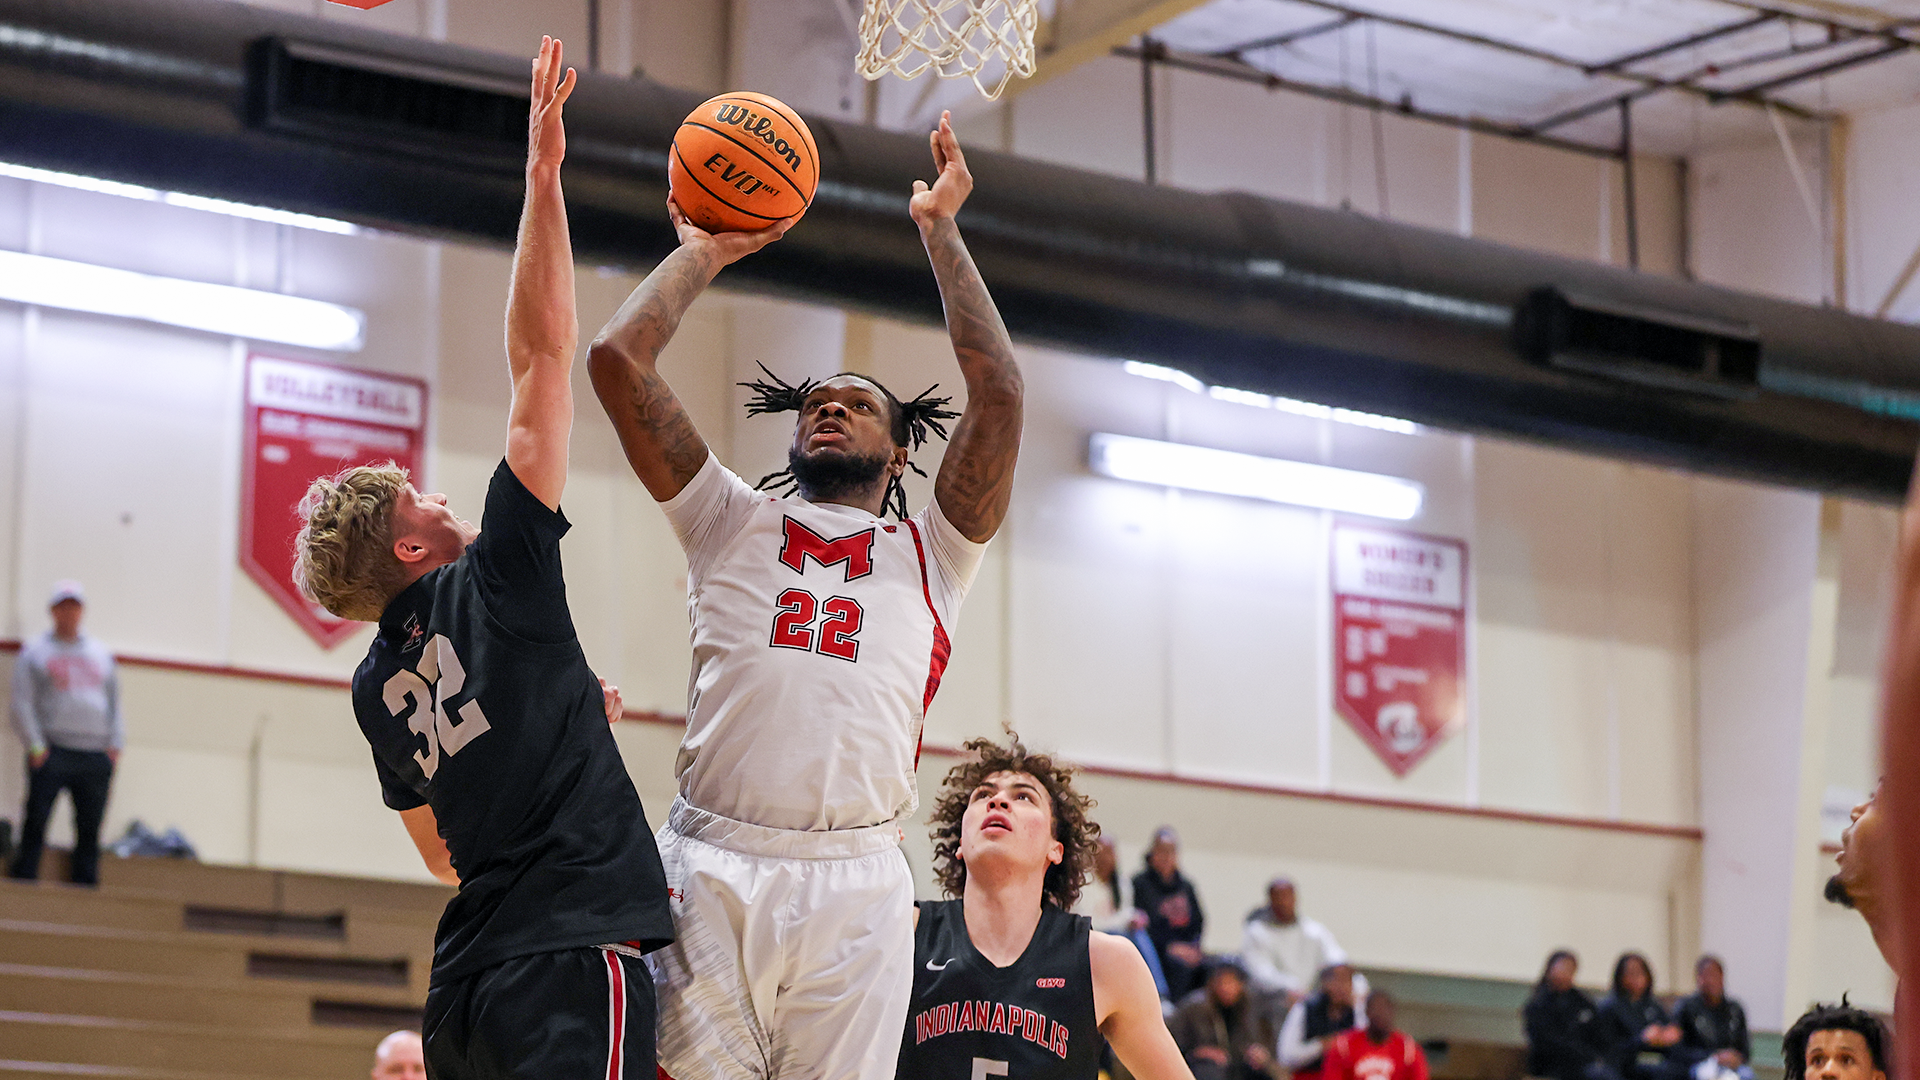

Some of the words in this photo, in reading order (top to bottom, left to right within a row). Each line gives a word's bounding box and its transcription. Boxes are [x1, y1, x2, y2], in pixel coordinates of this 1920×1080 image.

[715, 103, 801, 173] Wilson
[703, 152, 764, 196] EVO
[262, 373, 412, 417] VOLLEYBALL
[778, 514, 875, 583] M
[769, 587, 864, 663] 22
[382, 633, 491, 782] 32
[1036, 977, 1066, 988] GLVC
[915, 1000, 1069, 1060] INDIANAPOLIS
